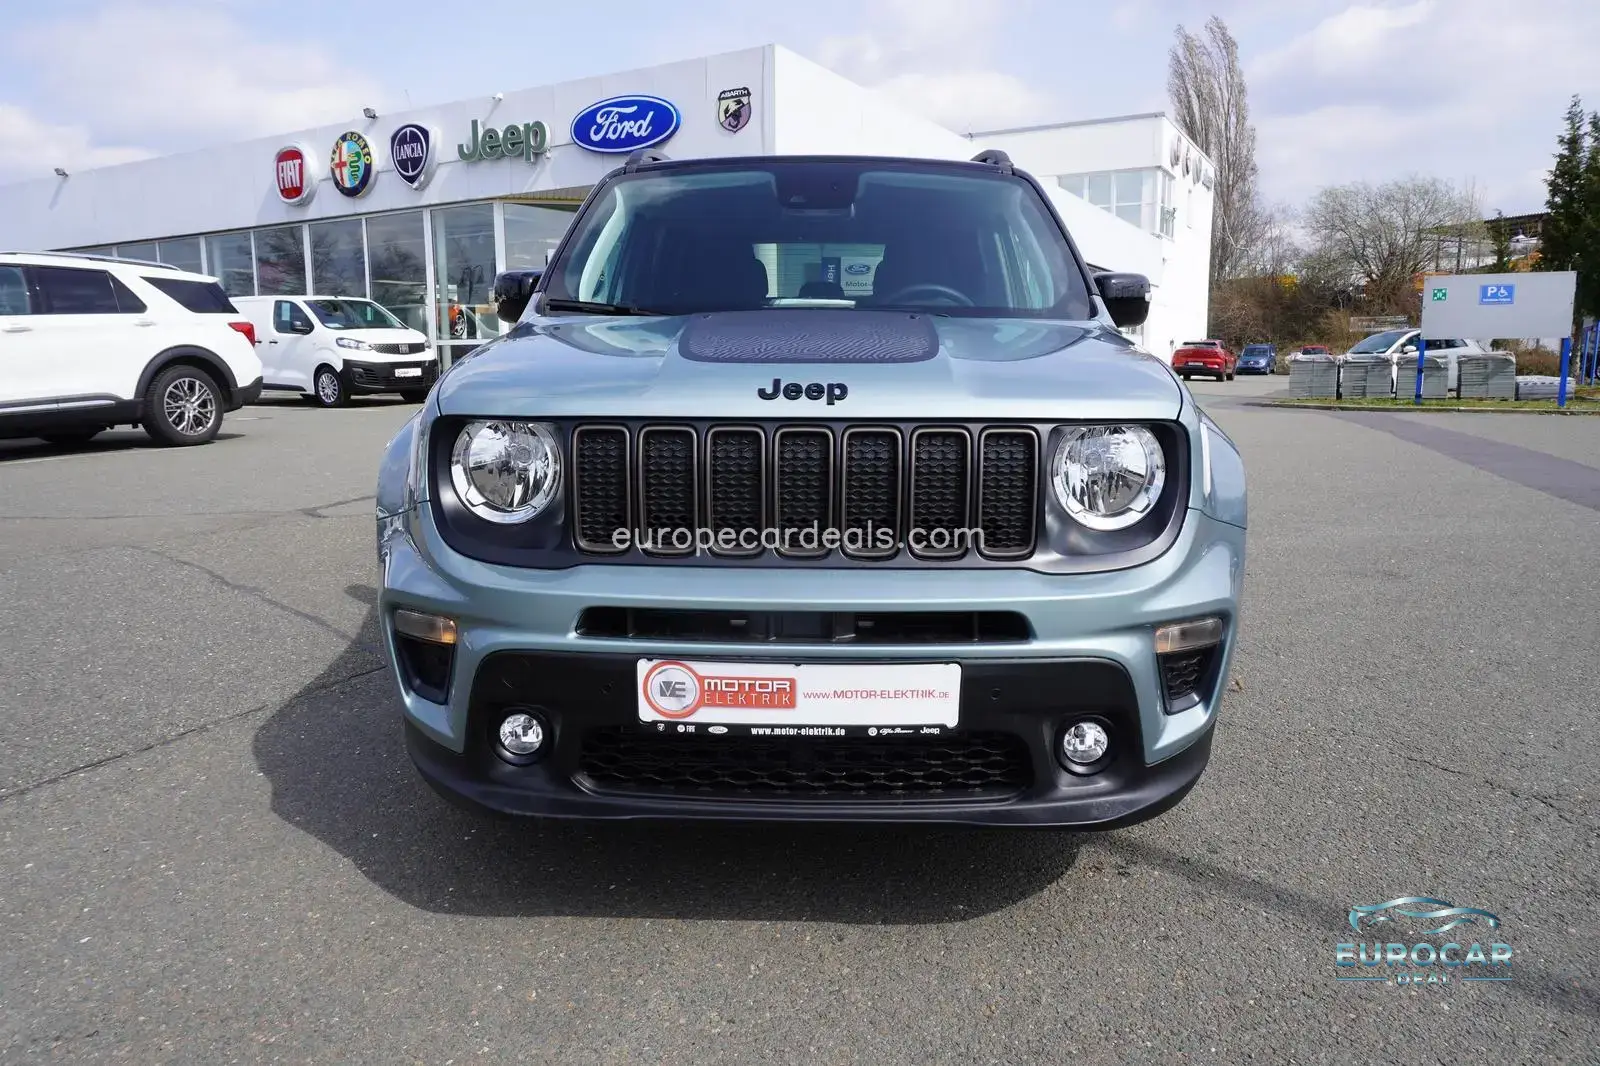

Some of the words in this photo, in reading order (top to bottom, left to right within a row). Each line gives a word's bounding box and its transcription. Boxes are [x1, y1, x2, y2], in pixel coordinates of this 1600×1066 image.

[720, 90, 748, 98] ABARTH
[590, 105, 653, 141] Ford
[346, 133, 371, 164] ROMEO
[457, 119, 547, 162] Jeep
[396, 143, 423, 160] LANCIA
[278, 159, 301, 190] FIAT
[1487, 286, 1498, 297] P
[757, 378, 848, 406] Jeep
[704, 679, 790, 692] MOTOR
[704, 692, 791, 705] ELEKTRIK
[750, 727, 846, 736] www.motor-elektrik.de
